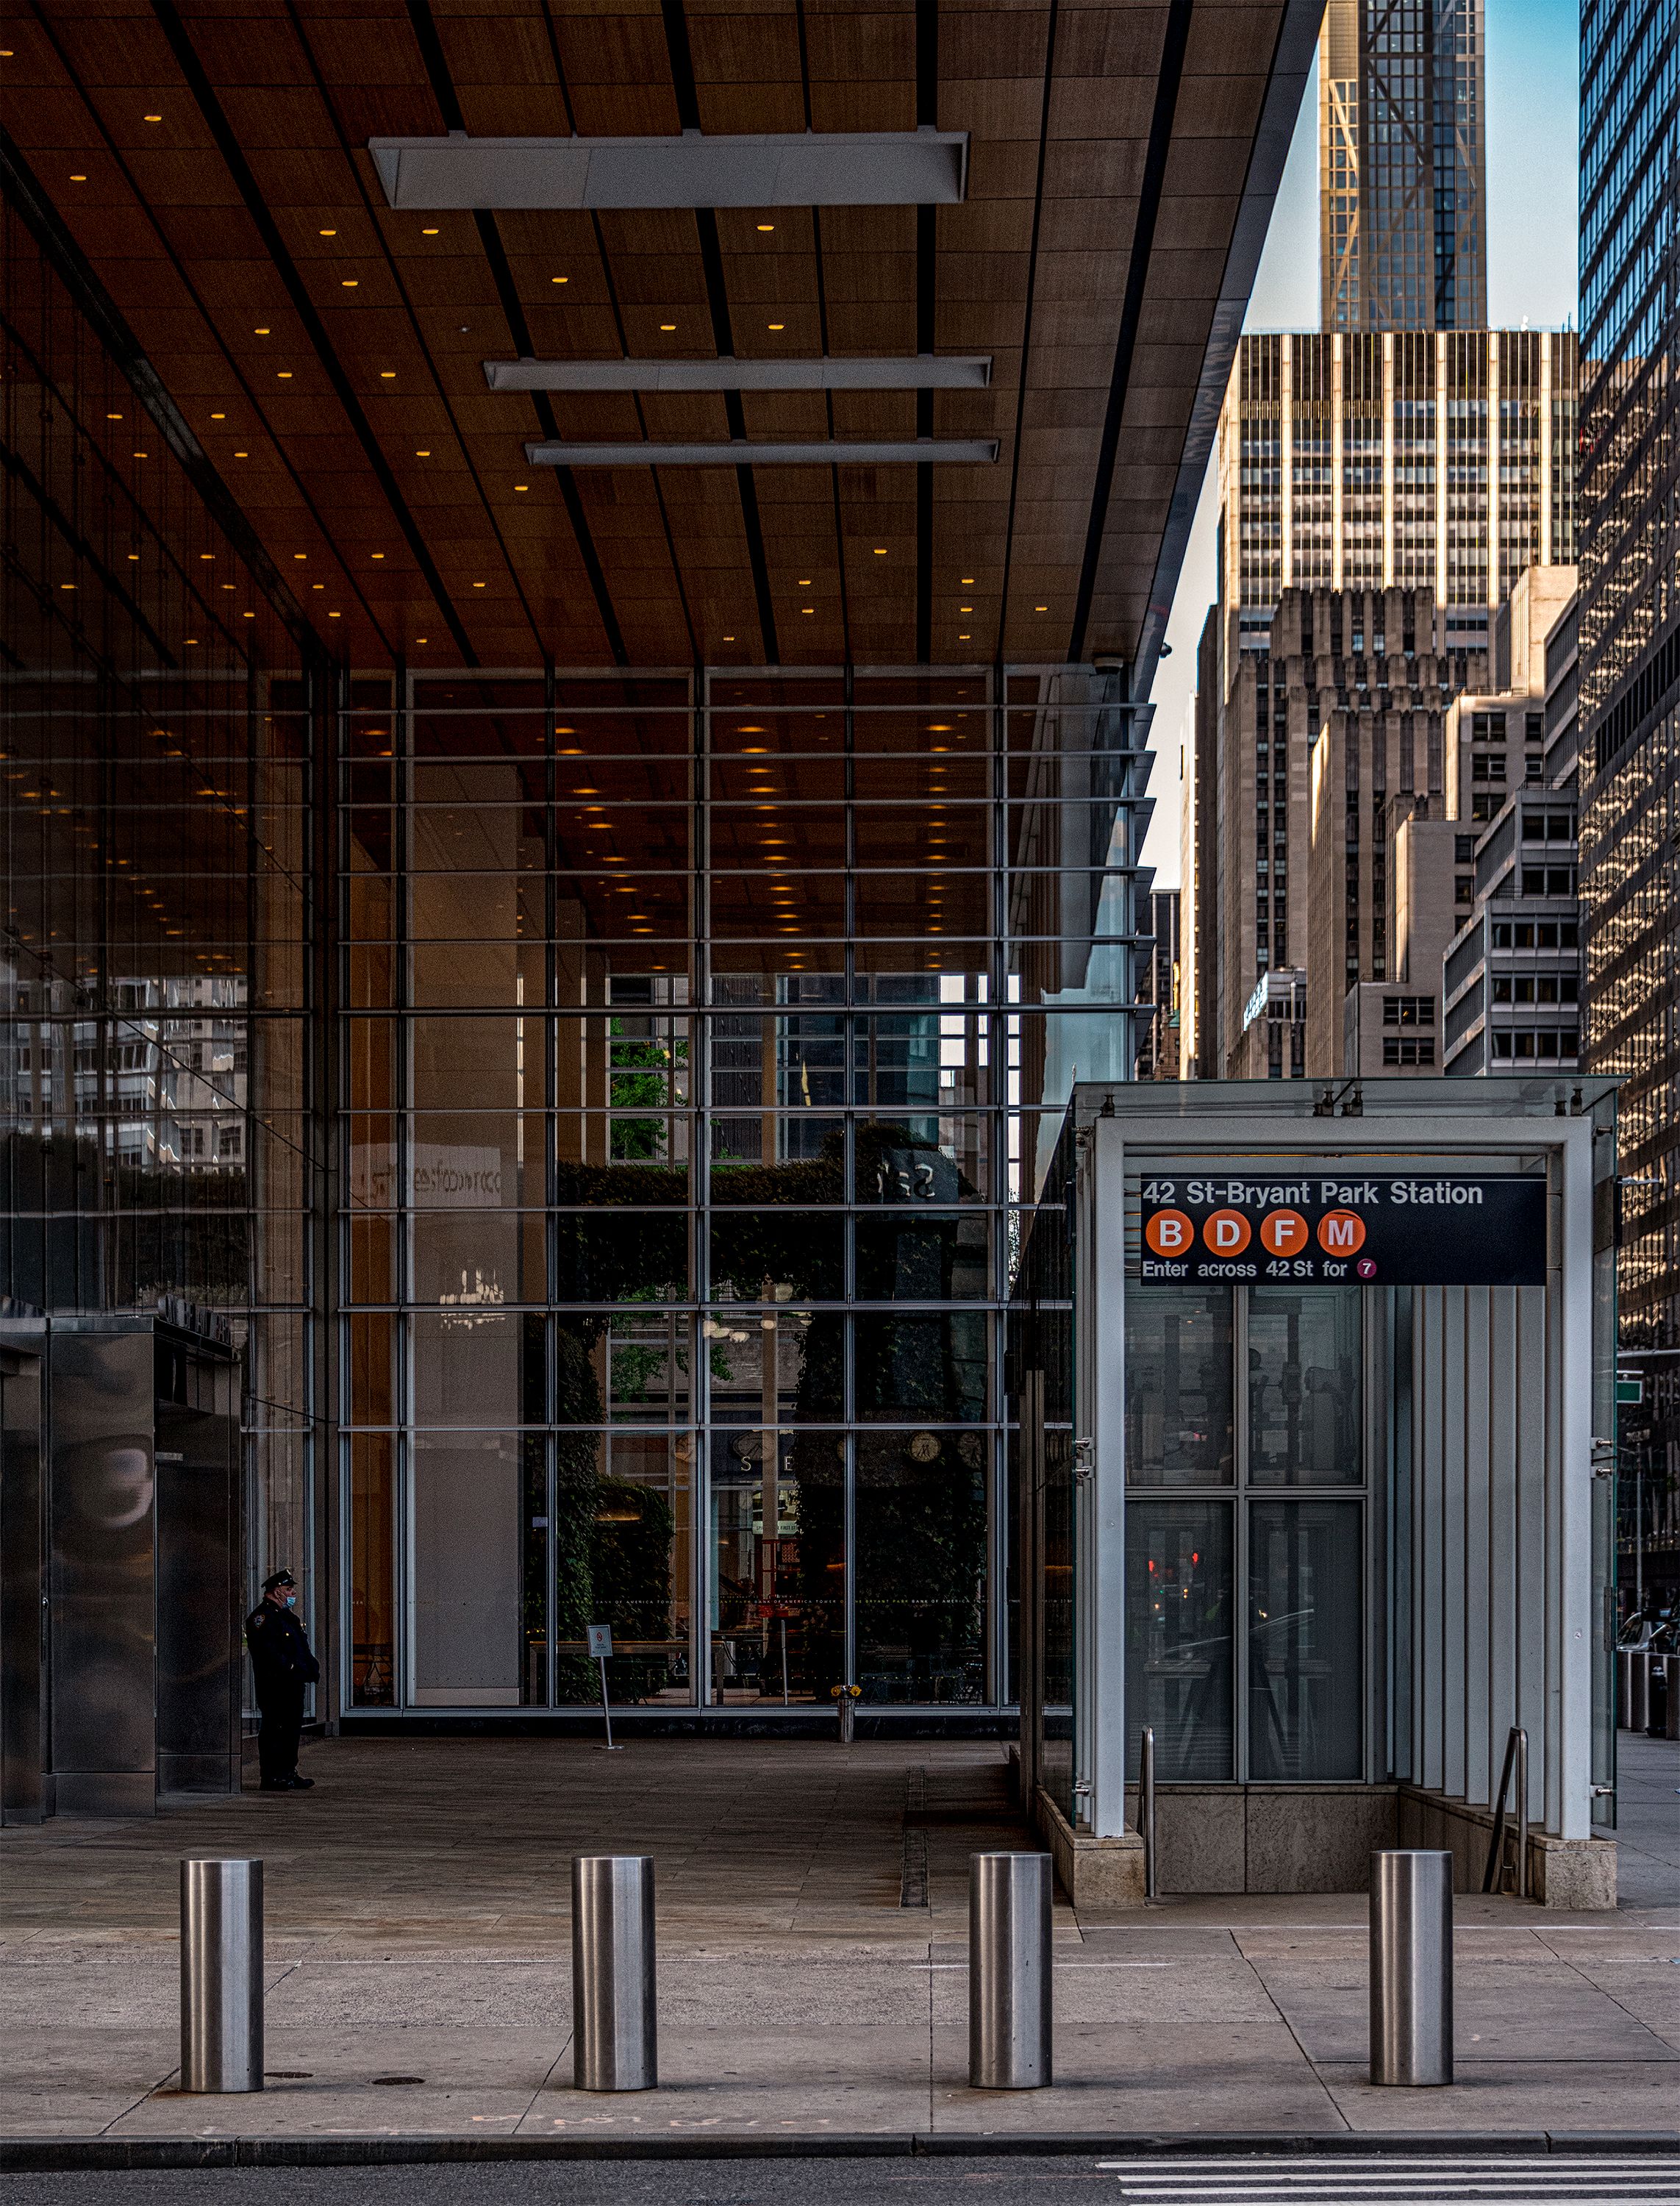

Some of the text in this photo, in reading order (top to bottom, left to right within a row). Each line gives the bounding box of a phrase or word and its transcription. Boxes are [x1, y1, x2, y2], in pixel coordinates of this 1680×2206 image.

[1143, 1181, 1483, 1209] 42 St-Bryant Park Station
[1159, 1219, 1354, 1246] B D F M
[1143, 1260, 1189, 1277] Enter
[1198, 1263, 1257, 1277] across
[1322, 1260, 1348, 1277] for
[1362, 1263, 1373, 1274] 7
